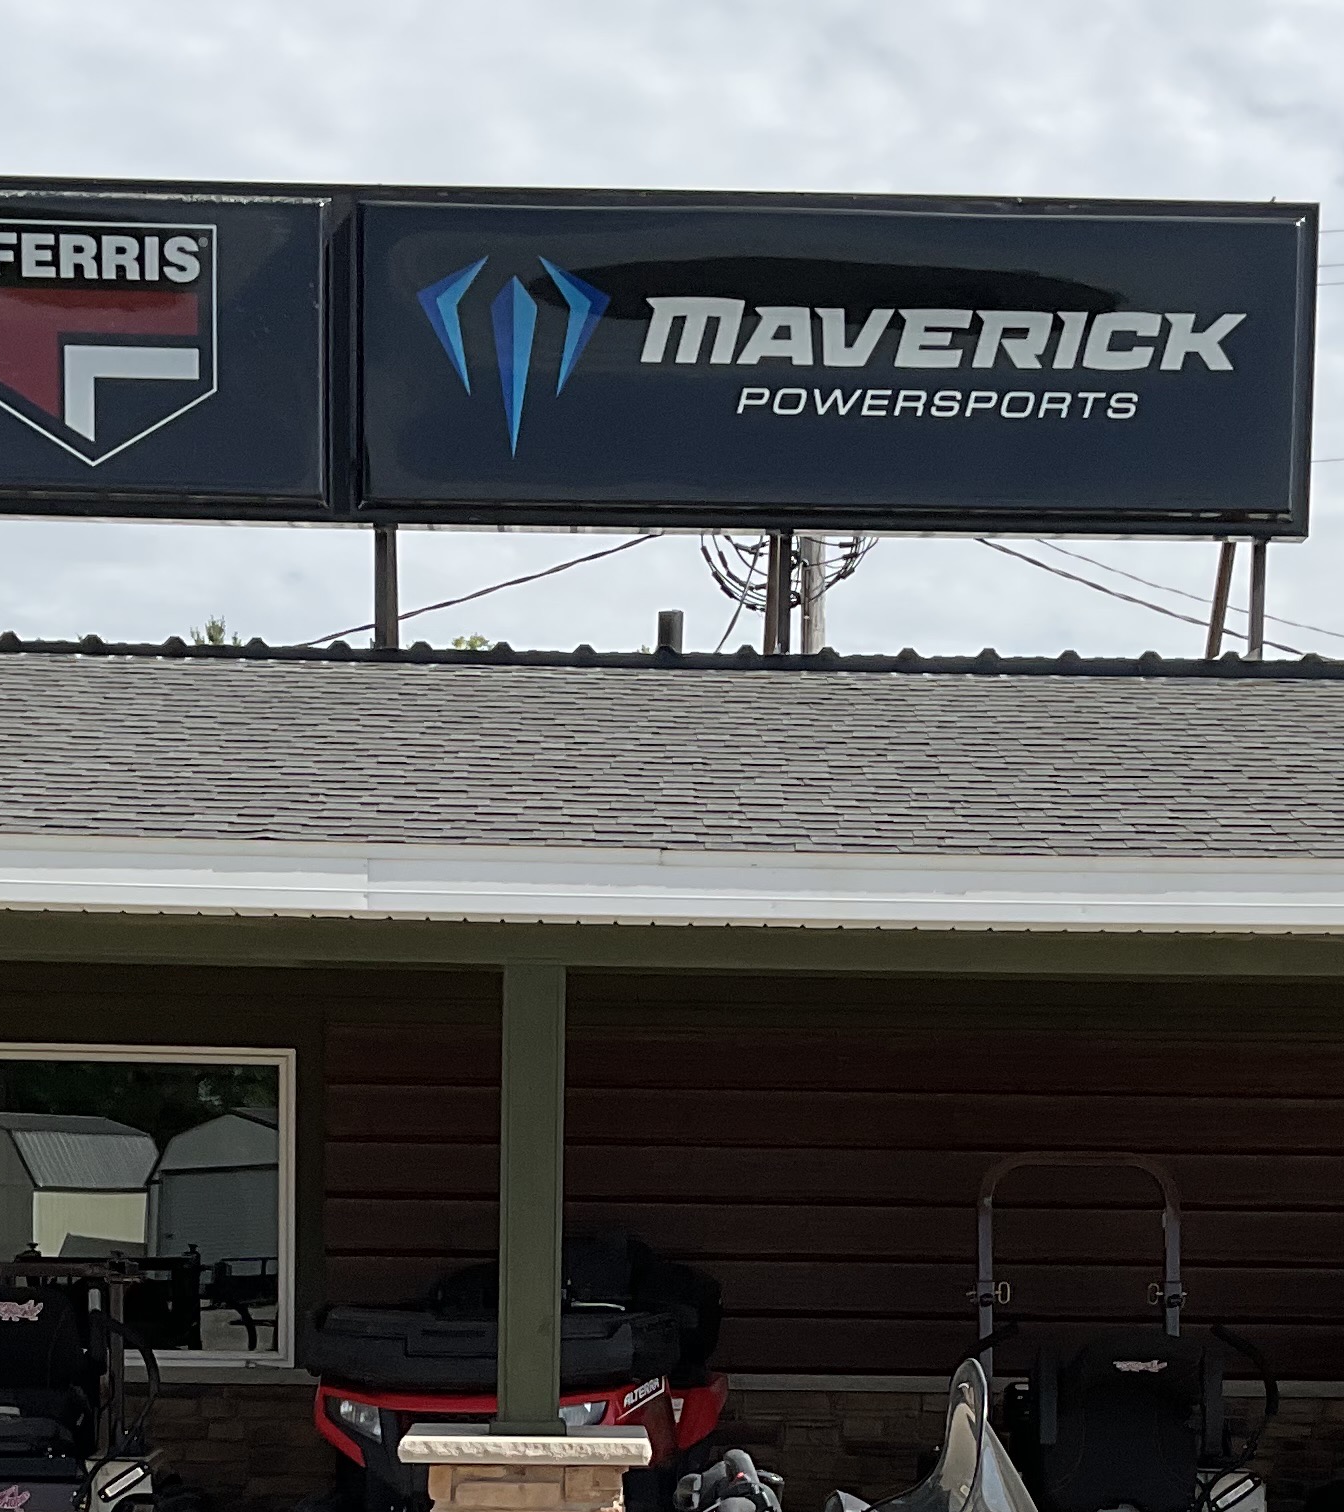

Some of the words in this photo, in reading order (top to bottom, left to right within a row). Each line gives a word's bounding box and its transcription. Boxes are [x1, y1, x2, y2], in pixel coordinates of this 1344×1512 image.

[639, 295, 1248, 372] MAVERICK
[736, 386, 1139, 420] POWERSPORTS
[623, 1377, 660, 1408] ALTERRA
